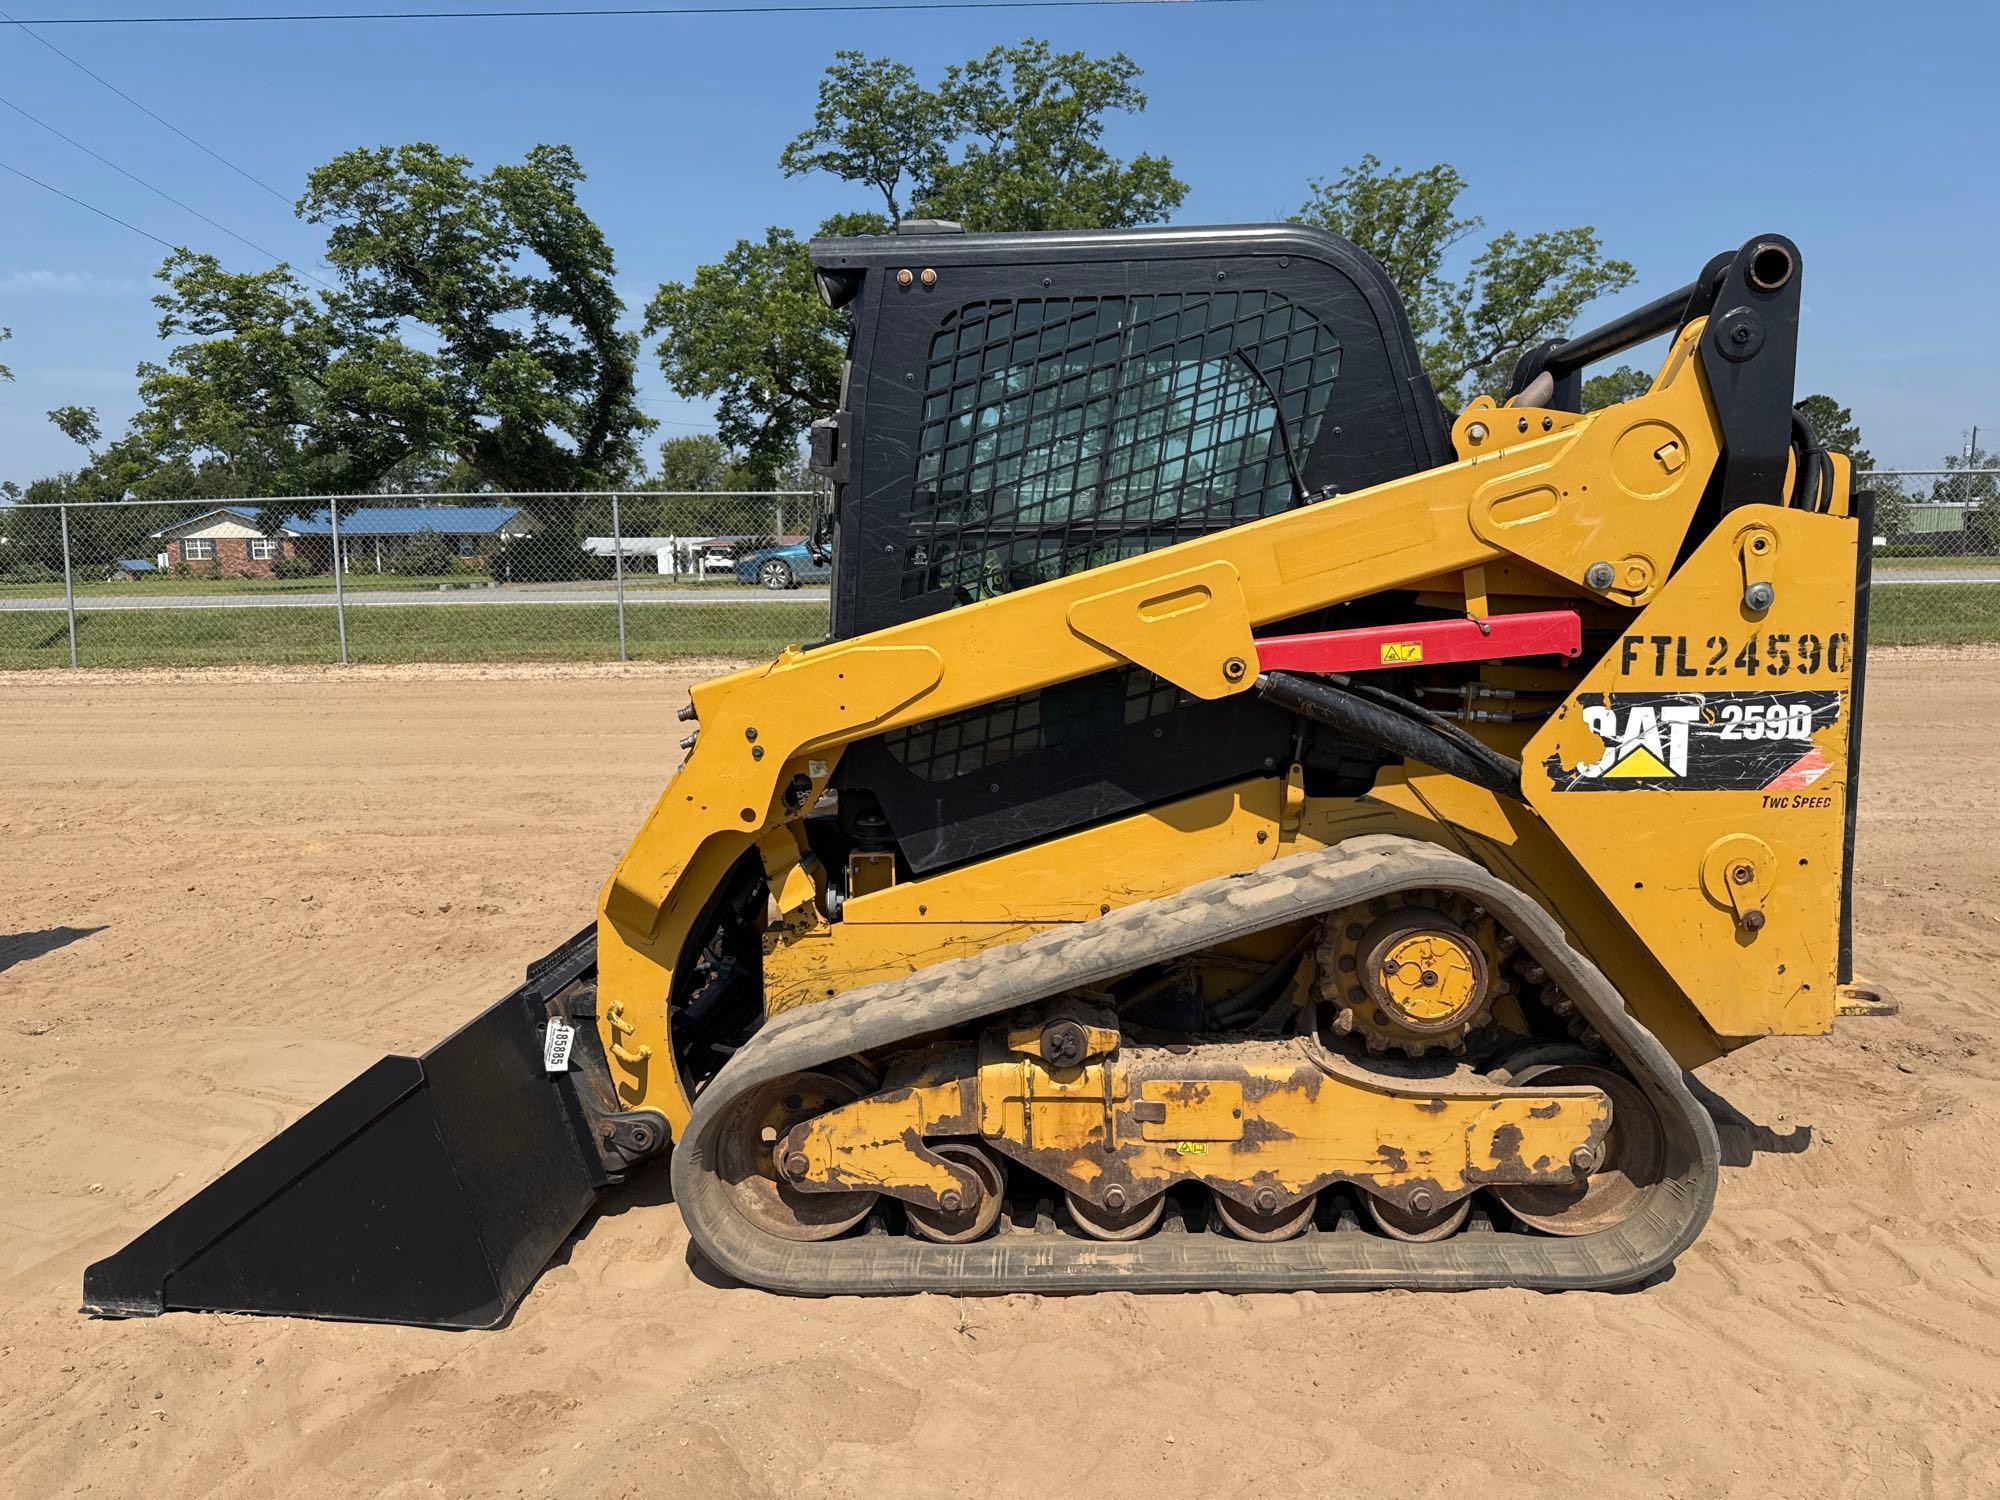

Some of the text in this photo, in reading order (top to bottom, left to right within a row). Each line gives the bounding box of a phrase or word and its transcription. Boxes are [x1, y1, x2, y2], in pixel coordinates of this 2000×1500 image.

[1621, 632, 1848, 677] FTL24590
[1720, 704, 1812, 740] 259D
[551, 1027, 570, 1065] 185885
